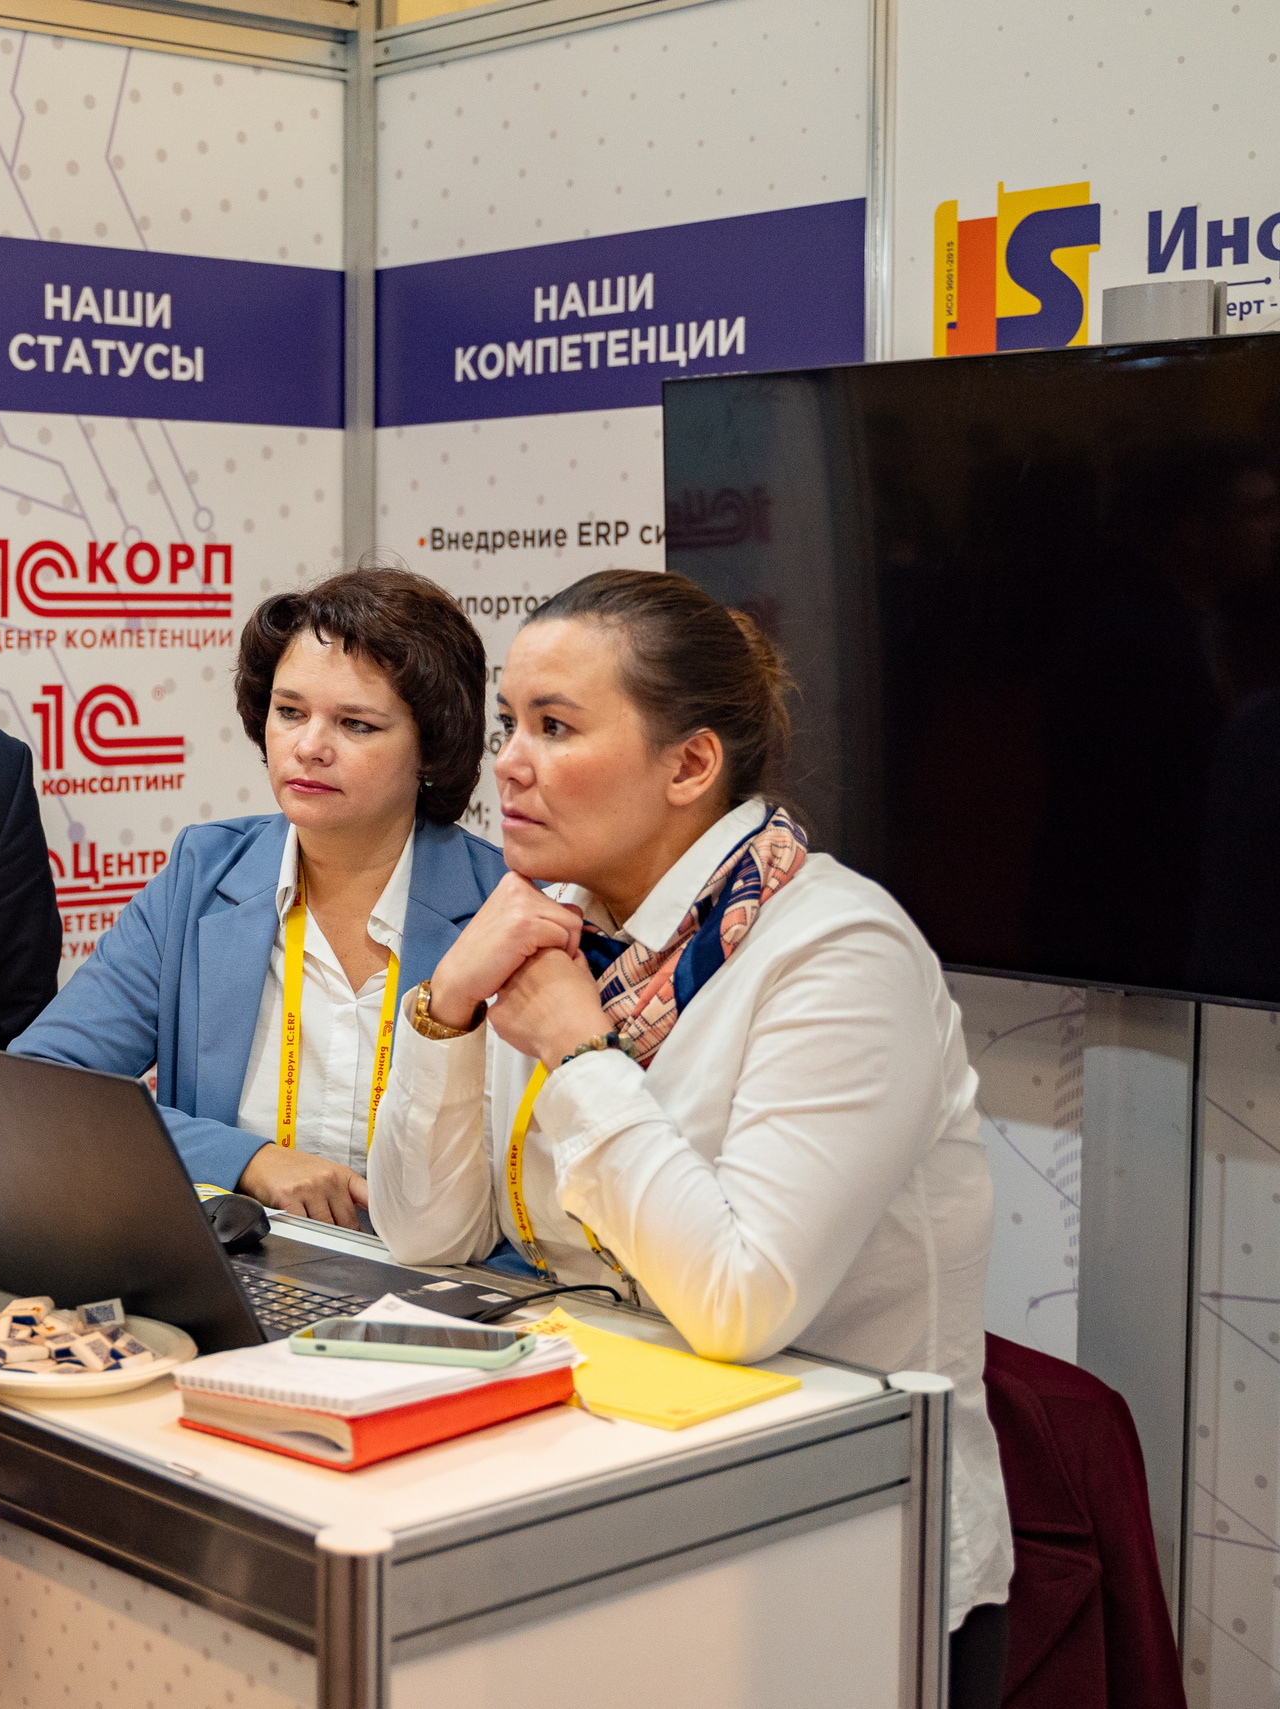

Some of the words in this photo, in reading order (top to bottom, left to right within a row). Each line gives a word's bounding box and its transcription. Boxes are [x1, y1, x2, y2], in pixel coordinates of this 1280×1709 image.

[44, 283, 172, 329] НАШИ
[534, 272, 654, 323] НАШИ
[8, 333, 204, 382] СТАТУСЫ
[454, 316, 746, 382] КОМПЕТЕНЦИИ
[431, 527, 567, 554] Внедрение
[578, 521, 629, 547] ERP
[65, 629, 234, 652] КОМПЕТЕНЦИИ
[286, 1012, 295, 1046] 1С:ERP
[283, 1051, 296, 1125] Бизнес-форум
